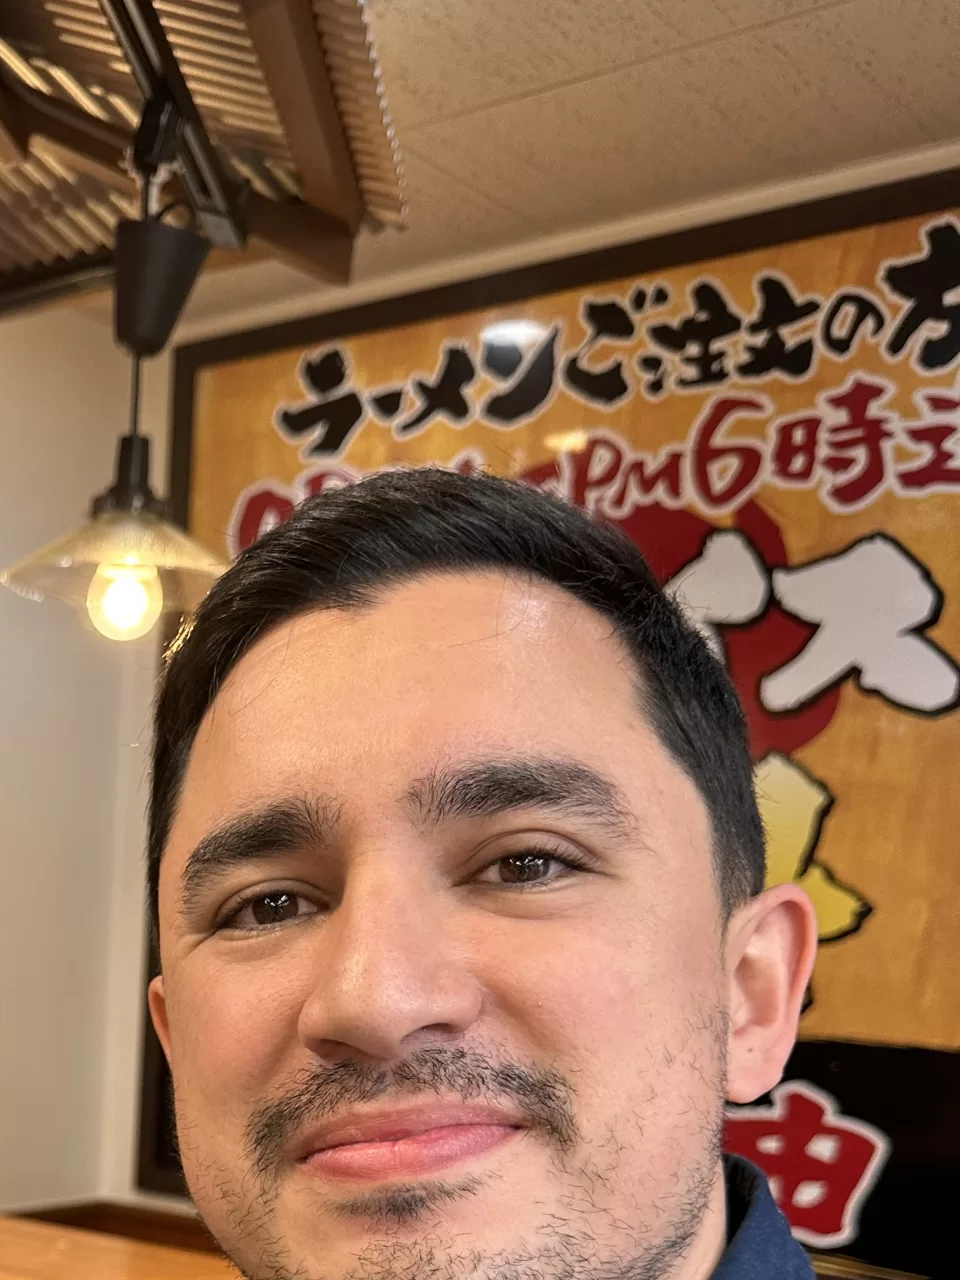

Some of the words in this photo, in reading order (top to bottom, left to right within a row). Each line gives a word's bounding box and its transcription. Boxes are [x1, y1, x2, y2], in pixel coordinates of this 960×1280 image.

[278, 220, 960, 455] ラーメンご注文の方
